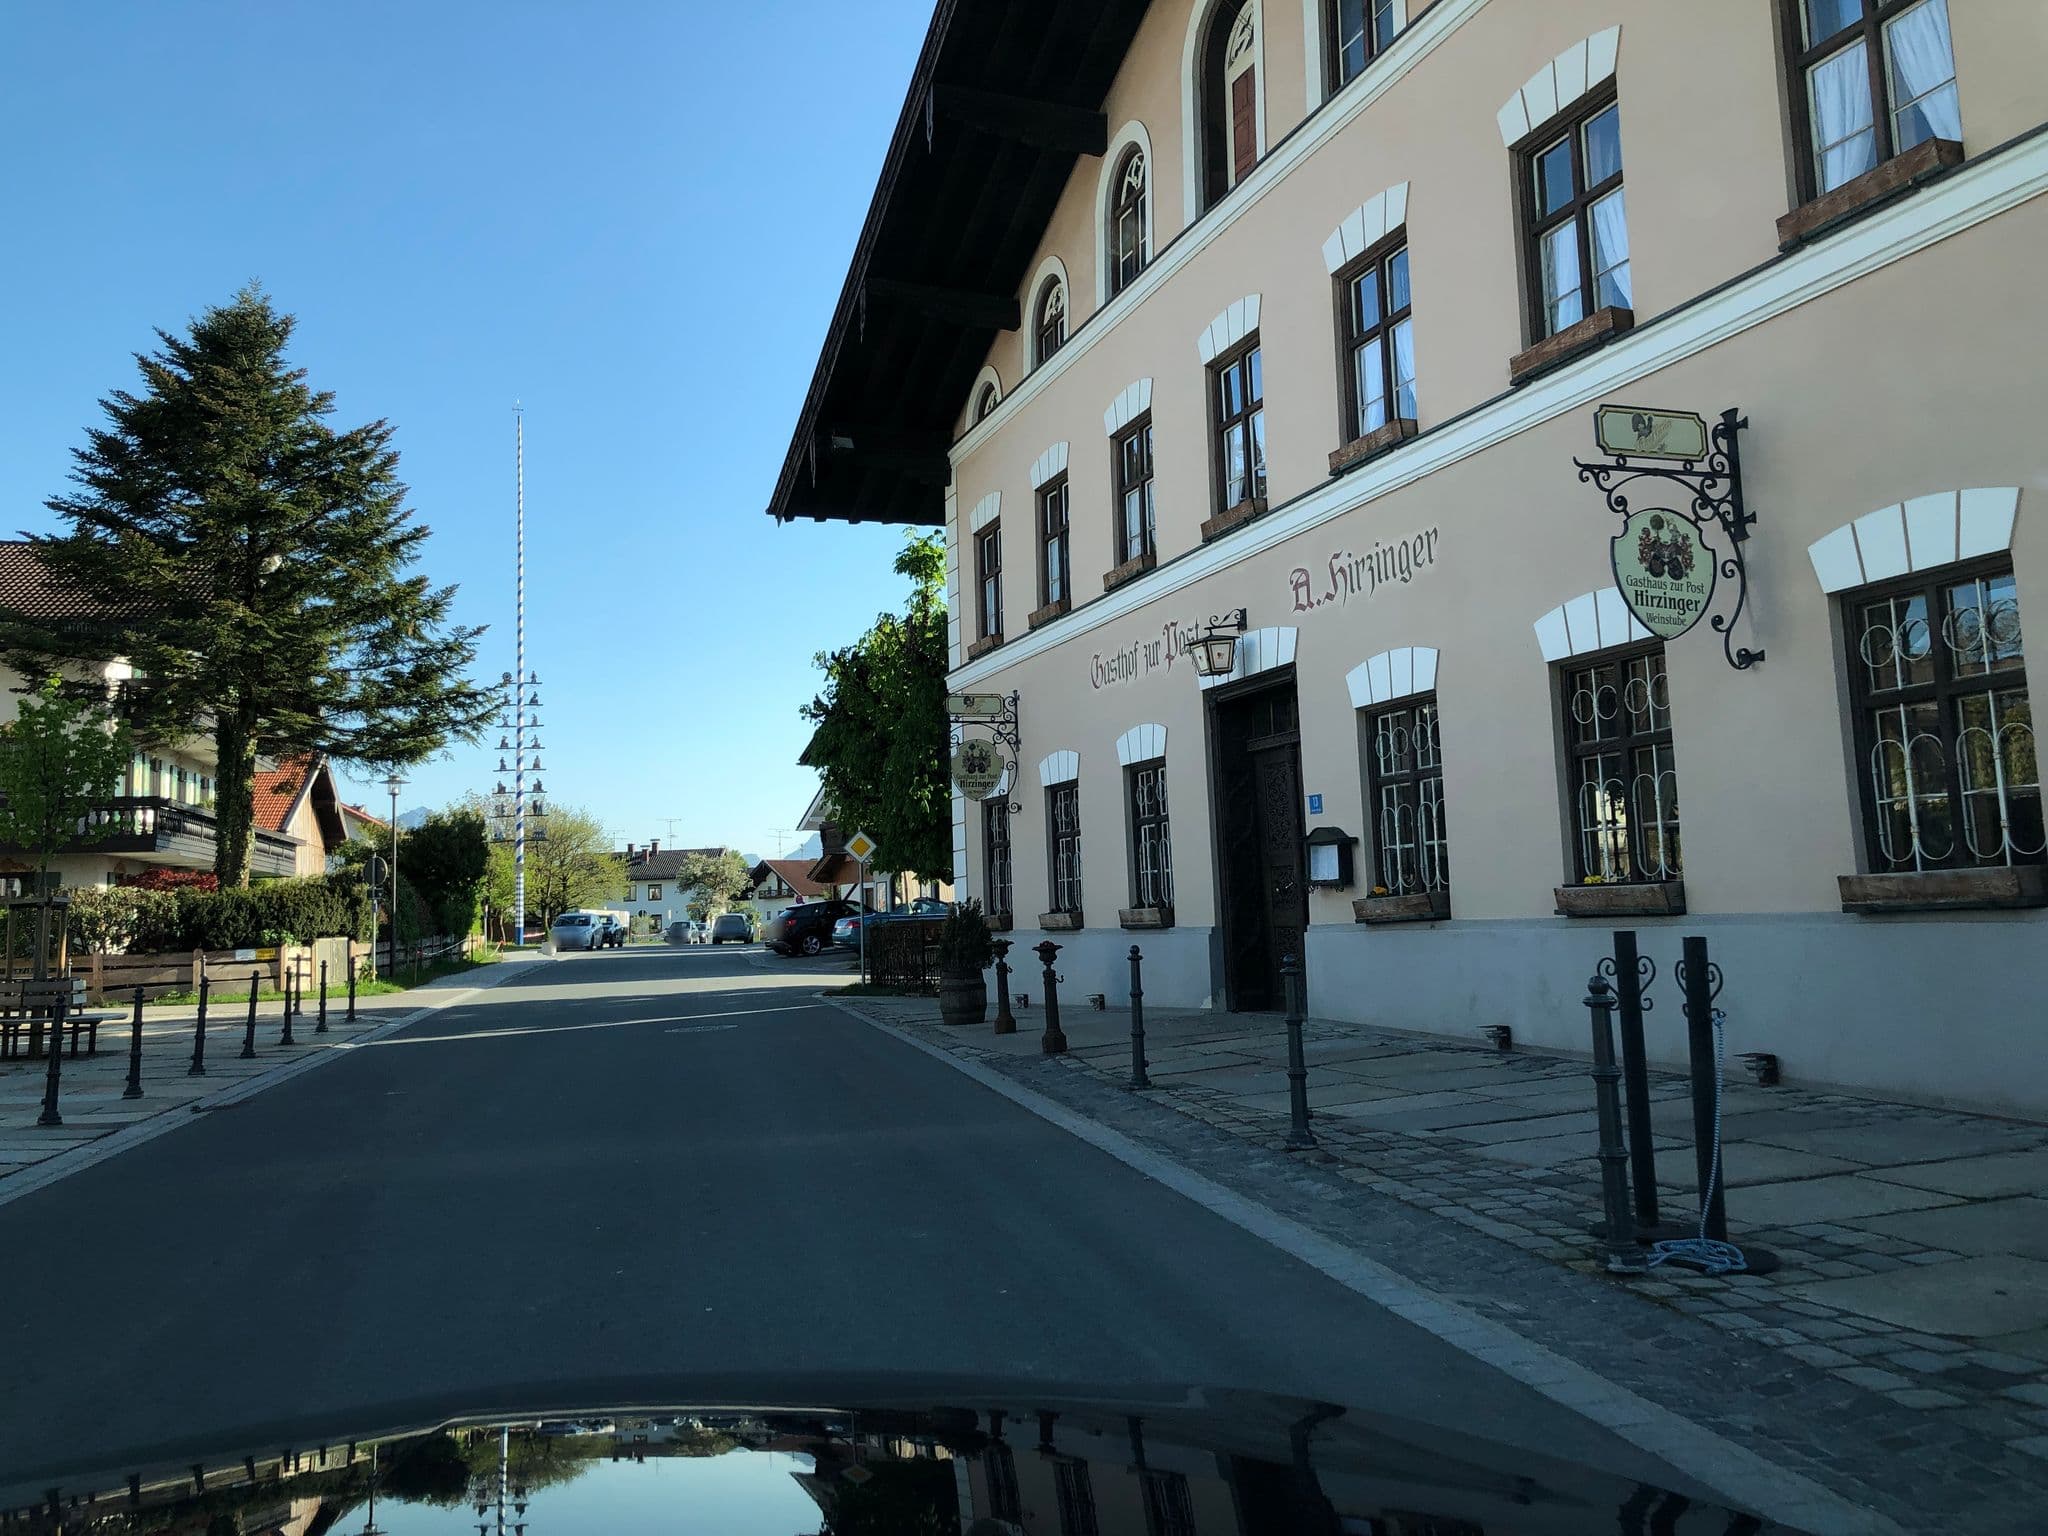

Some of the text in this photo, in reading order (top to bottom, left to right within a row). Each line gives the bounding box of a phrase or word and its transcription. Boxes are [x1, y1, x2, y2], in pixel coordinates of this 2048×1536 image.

[1626, 574, 1705, 595] Gasthaus zur Post
[1634, 589, 1701, 616] Hirzinger
[1646, 612, 1687, 627] Weinstube
[1090, 640, 1139, 689] Gasthof
[1144, 640, 1160, 676] zur
[960, 780, 995, 789] Hirzinger
